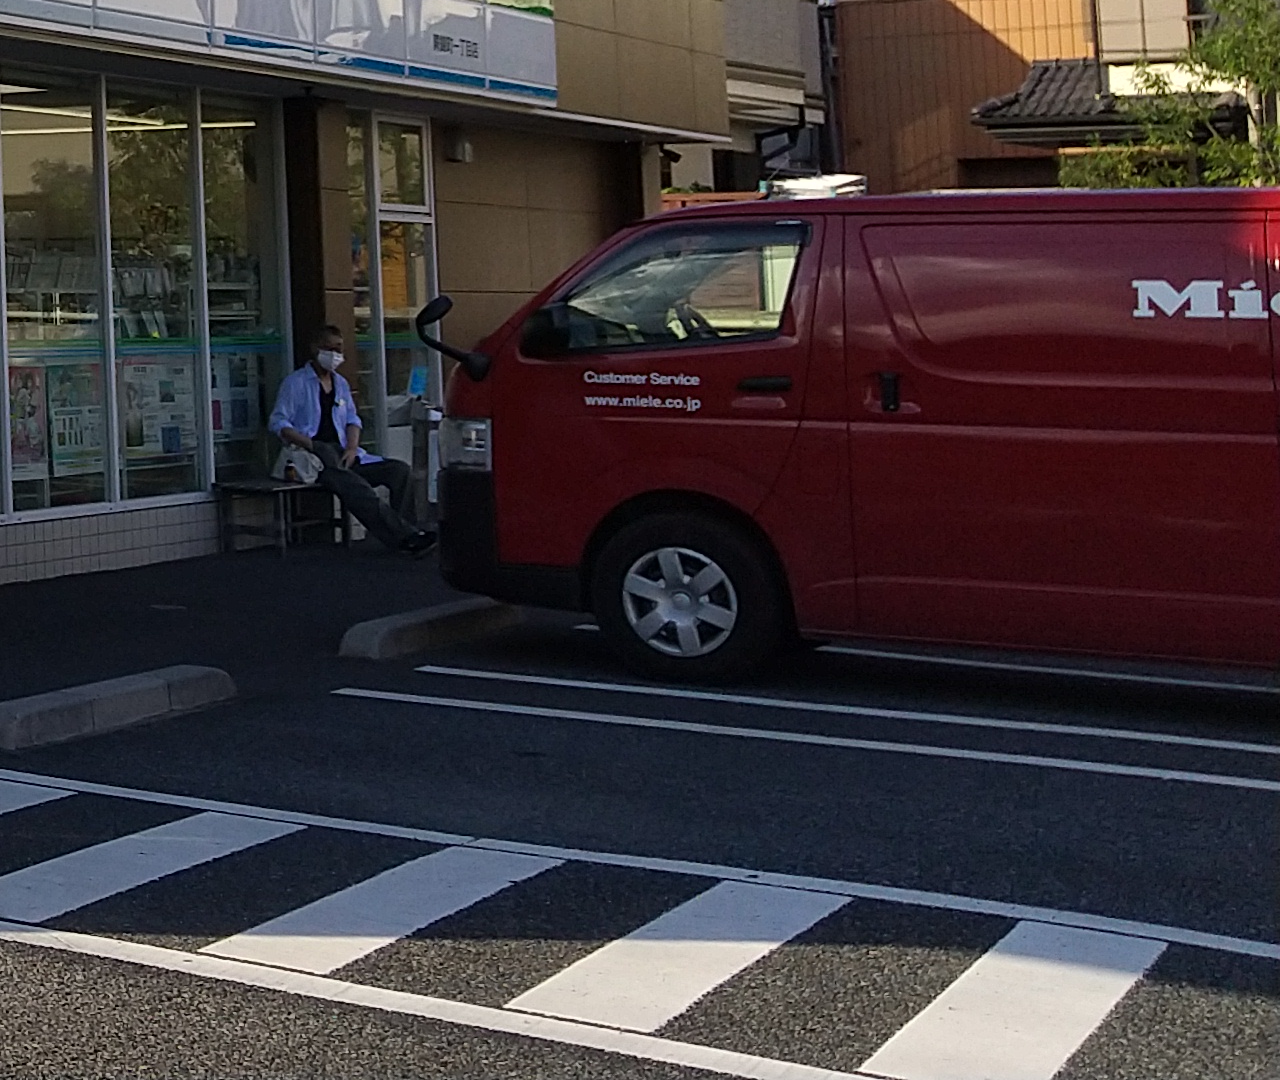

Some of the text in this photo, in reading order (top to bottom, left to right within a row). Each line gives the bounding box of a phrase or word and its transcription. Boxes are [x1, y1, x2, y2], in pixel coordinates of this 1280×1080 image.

[1132, 279, 1280, 319] Mi
[583, 370, 700, 386] Customer Service
[583, 394, 702, 412] www.miele.co.jp
